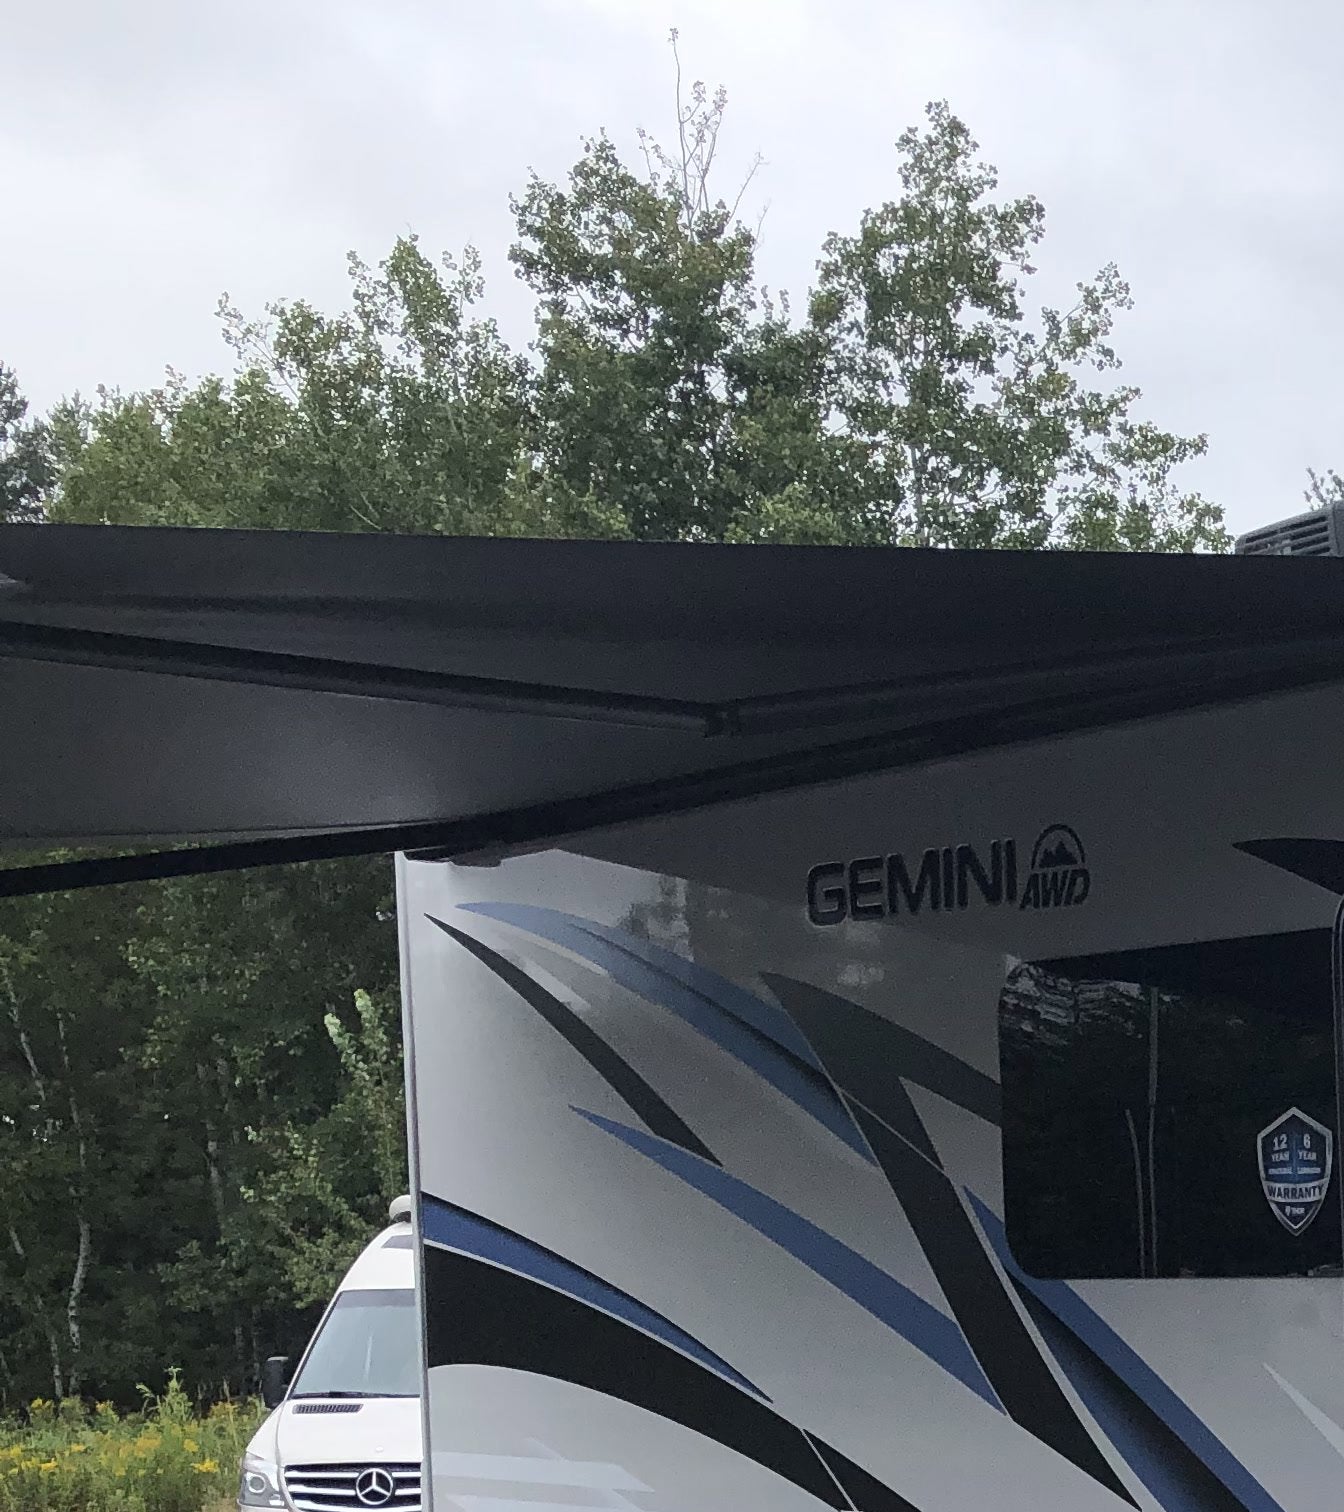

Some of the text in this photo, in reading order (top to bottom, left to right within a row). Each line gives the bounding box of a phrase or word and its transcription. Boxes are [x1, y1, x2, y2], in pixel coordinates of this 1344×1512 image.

[806, 837, 1018, 927] GEMINI
[1019, 867, 1091, 911] AWD
[1272, 1133, 1288, 1151] 12
[1266, 1182, 1325, 1200] WARRANTY
